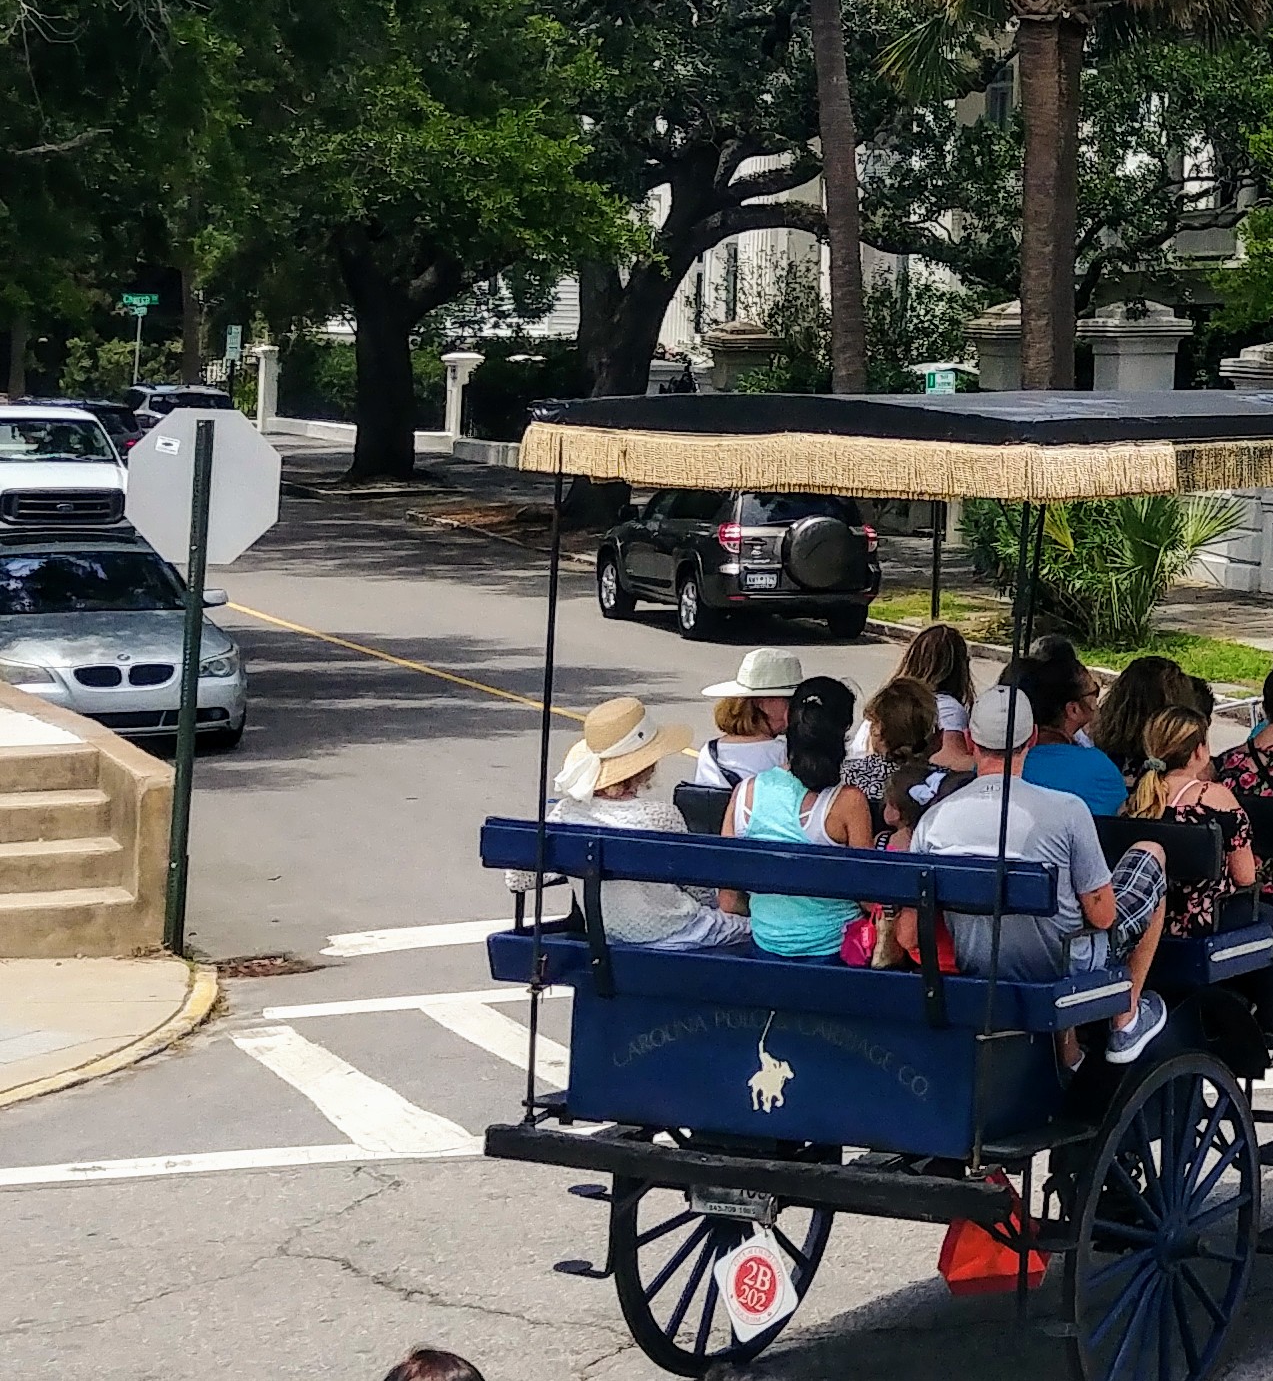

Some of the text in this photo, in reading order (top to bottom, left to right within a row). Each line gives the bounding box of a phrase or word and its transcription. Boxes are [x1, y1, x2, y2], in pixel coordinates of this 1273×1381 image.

[612, 1014, 708, 1068] CAROLINA
[743, 1260, 772, 1291] 2B
[737, 1285, 767, 1311] 202
